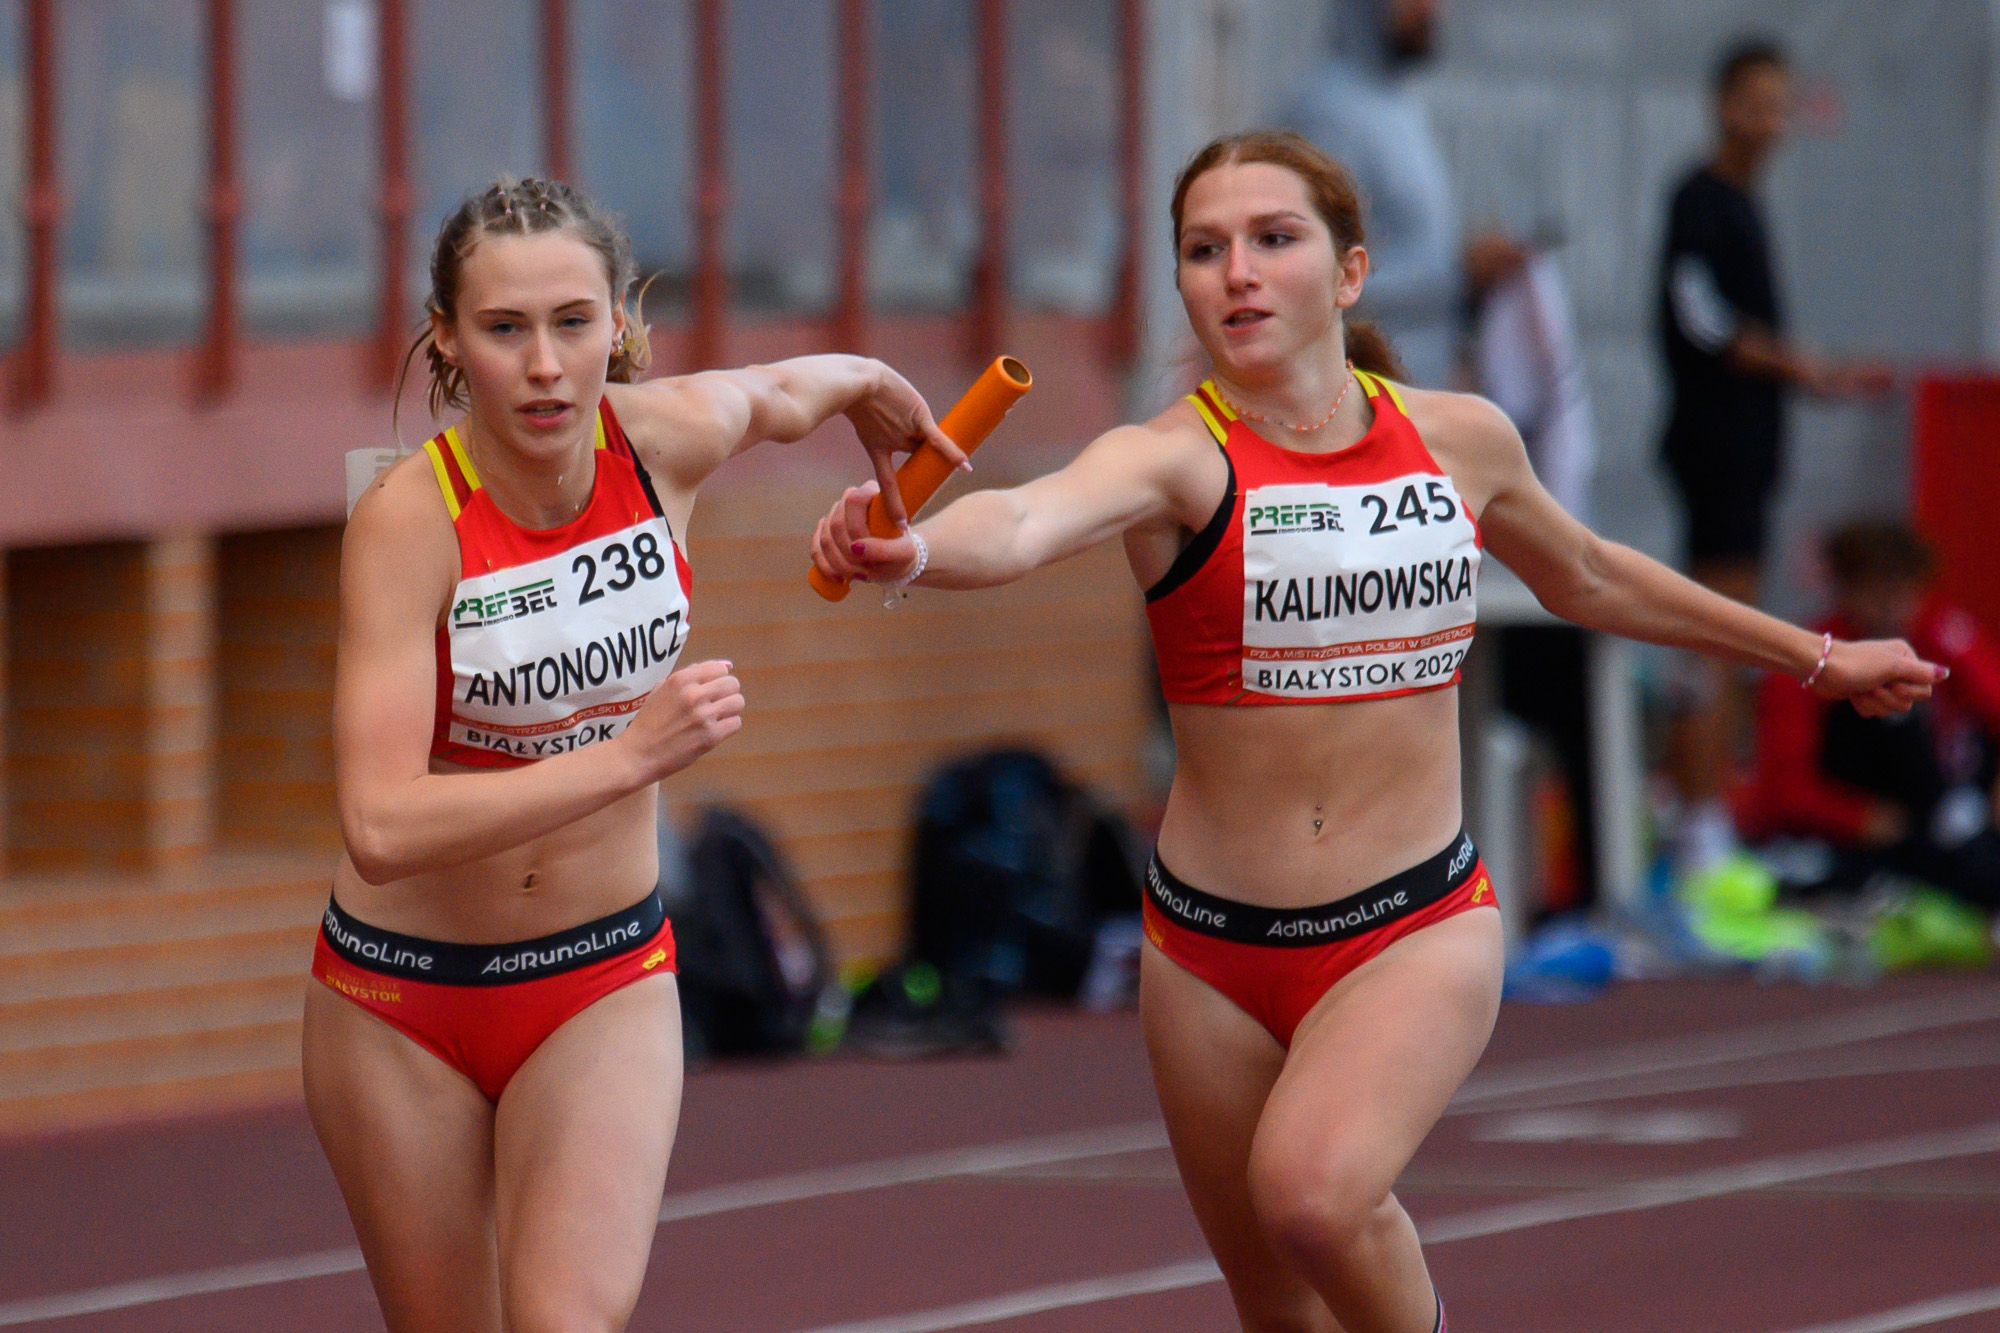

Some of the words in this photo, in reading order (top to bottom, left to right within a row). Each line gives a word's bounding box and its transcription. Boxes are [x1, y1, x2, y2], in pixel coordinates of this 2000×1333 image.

[1361, 482, 1457, 535] 245
[572, 532, 665, 606] 238
[1255, 556, 1472, 623] KALINOWSKA
[465, 610, 681, 706] ANTONOWICZ
[1250, 649, 1281, 659] PZLA
[1283, 645, 1363, 659] MISTRZOSTWA
[1365, 641, 1405, 652] POLSKI
[1407, 640, 1418, 649] W
[1420, 627, 1472, 647] SZTAFETACH
[1258, 661, 1406, 690] BIAŁYSTOK
[1414, 649, 1464, 680] 2022
[576, 706, 616, 720] POLSKI
[619, 703, 629, 712] W
[467, 723, 615, 755] BIAŁYSTOK
